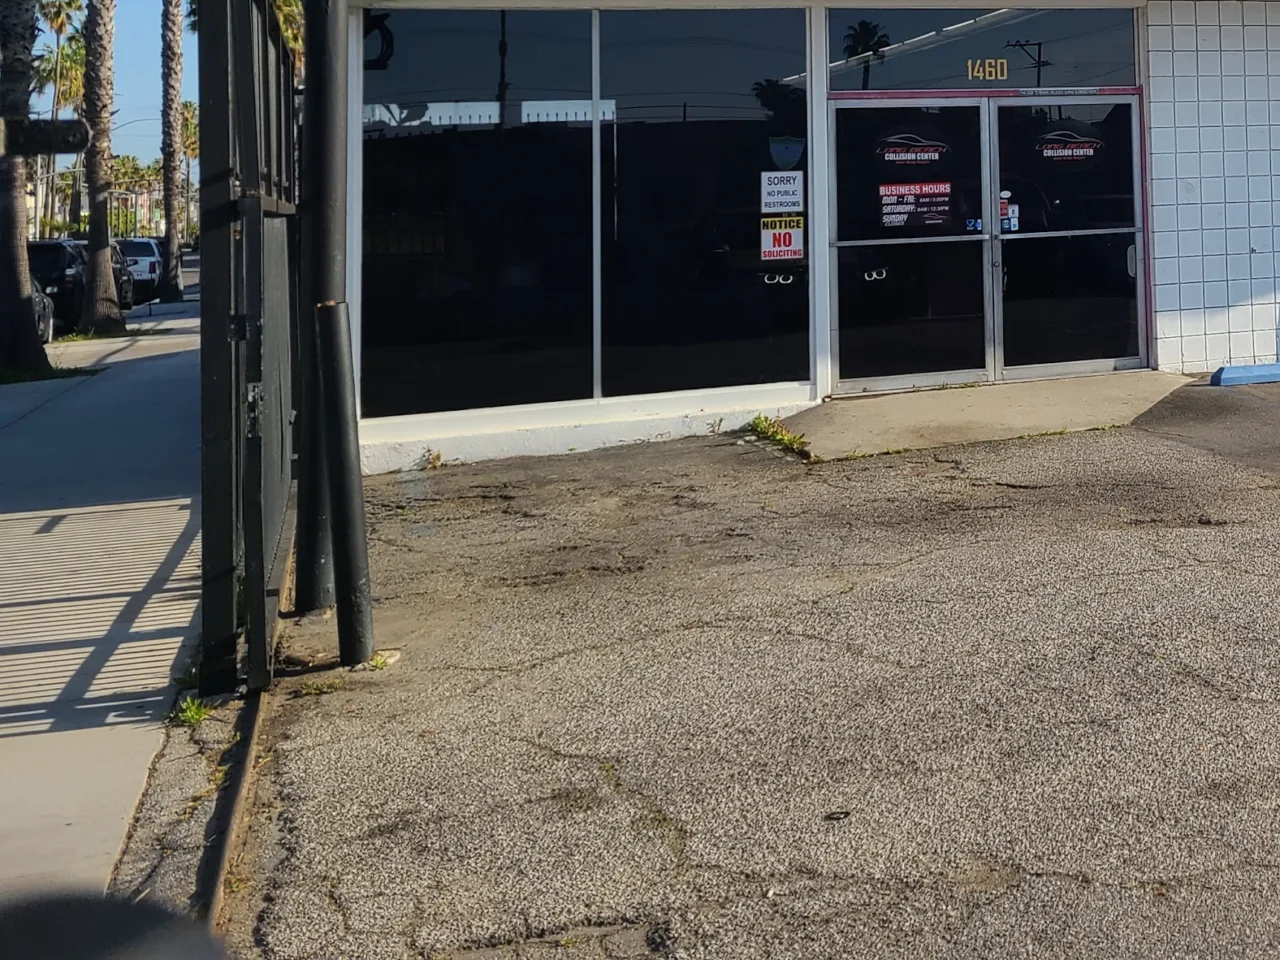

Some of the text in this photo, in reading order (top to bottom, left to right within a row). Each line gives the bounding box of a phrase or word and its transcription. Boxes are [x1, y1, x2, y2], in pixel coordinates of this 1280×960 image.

[967, 59, 1008, 80] 1460
[884, 152, 939, 161] COLLISION CENTER
[1043, 148, 1094, 157] COLLISION CENTER
[767, 175, 798, 186] SORRY
[777, 189, 798, 197] PUBLIC
[880, 183, 951, 195] BUSINESS HOURS
[764, 200, 801, 209] RESTROOMS
[882, 196, 897, 204] MON
[882, 204, 917, 214] SATURDAY:
[882, 213, 908, 223] SUNDAY
[762, 219, 803, 230] NOTICE
[772, 232, 793, 248] NO
[762, 249, 803, 258] SOLICITING
